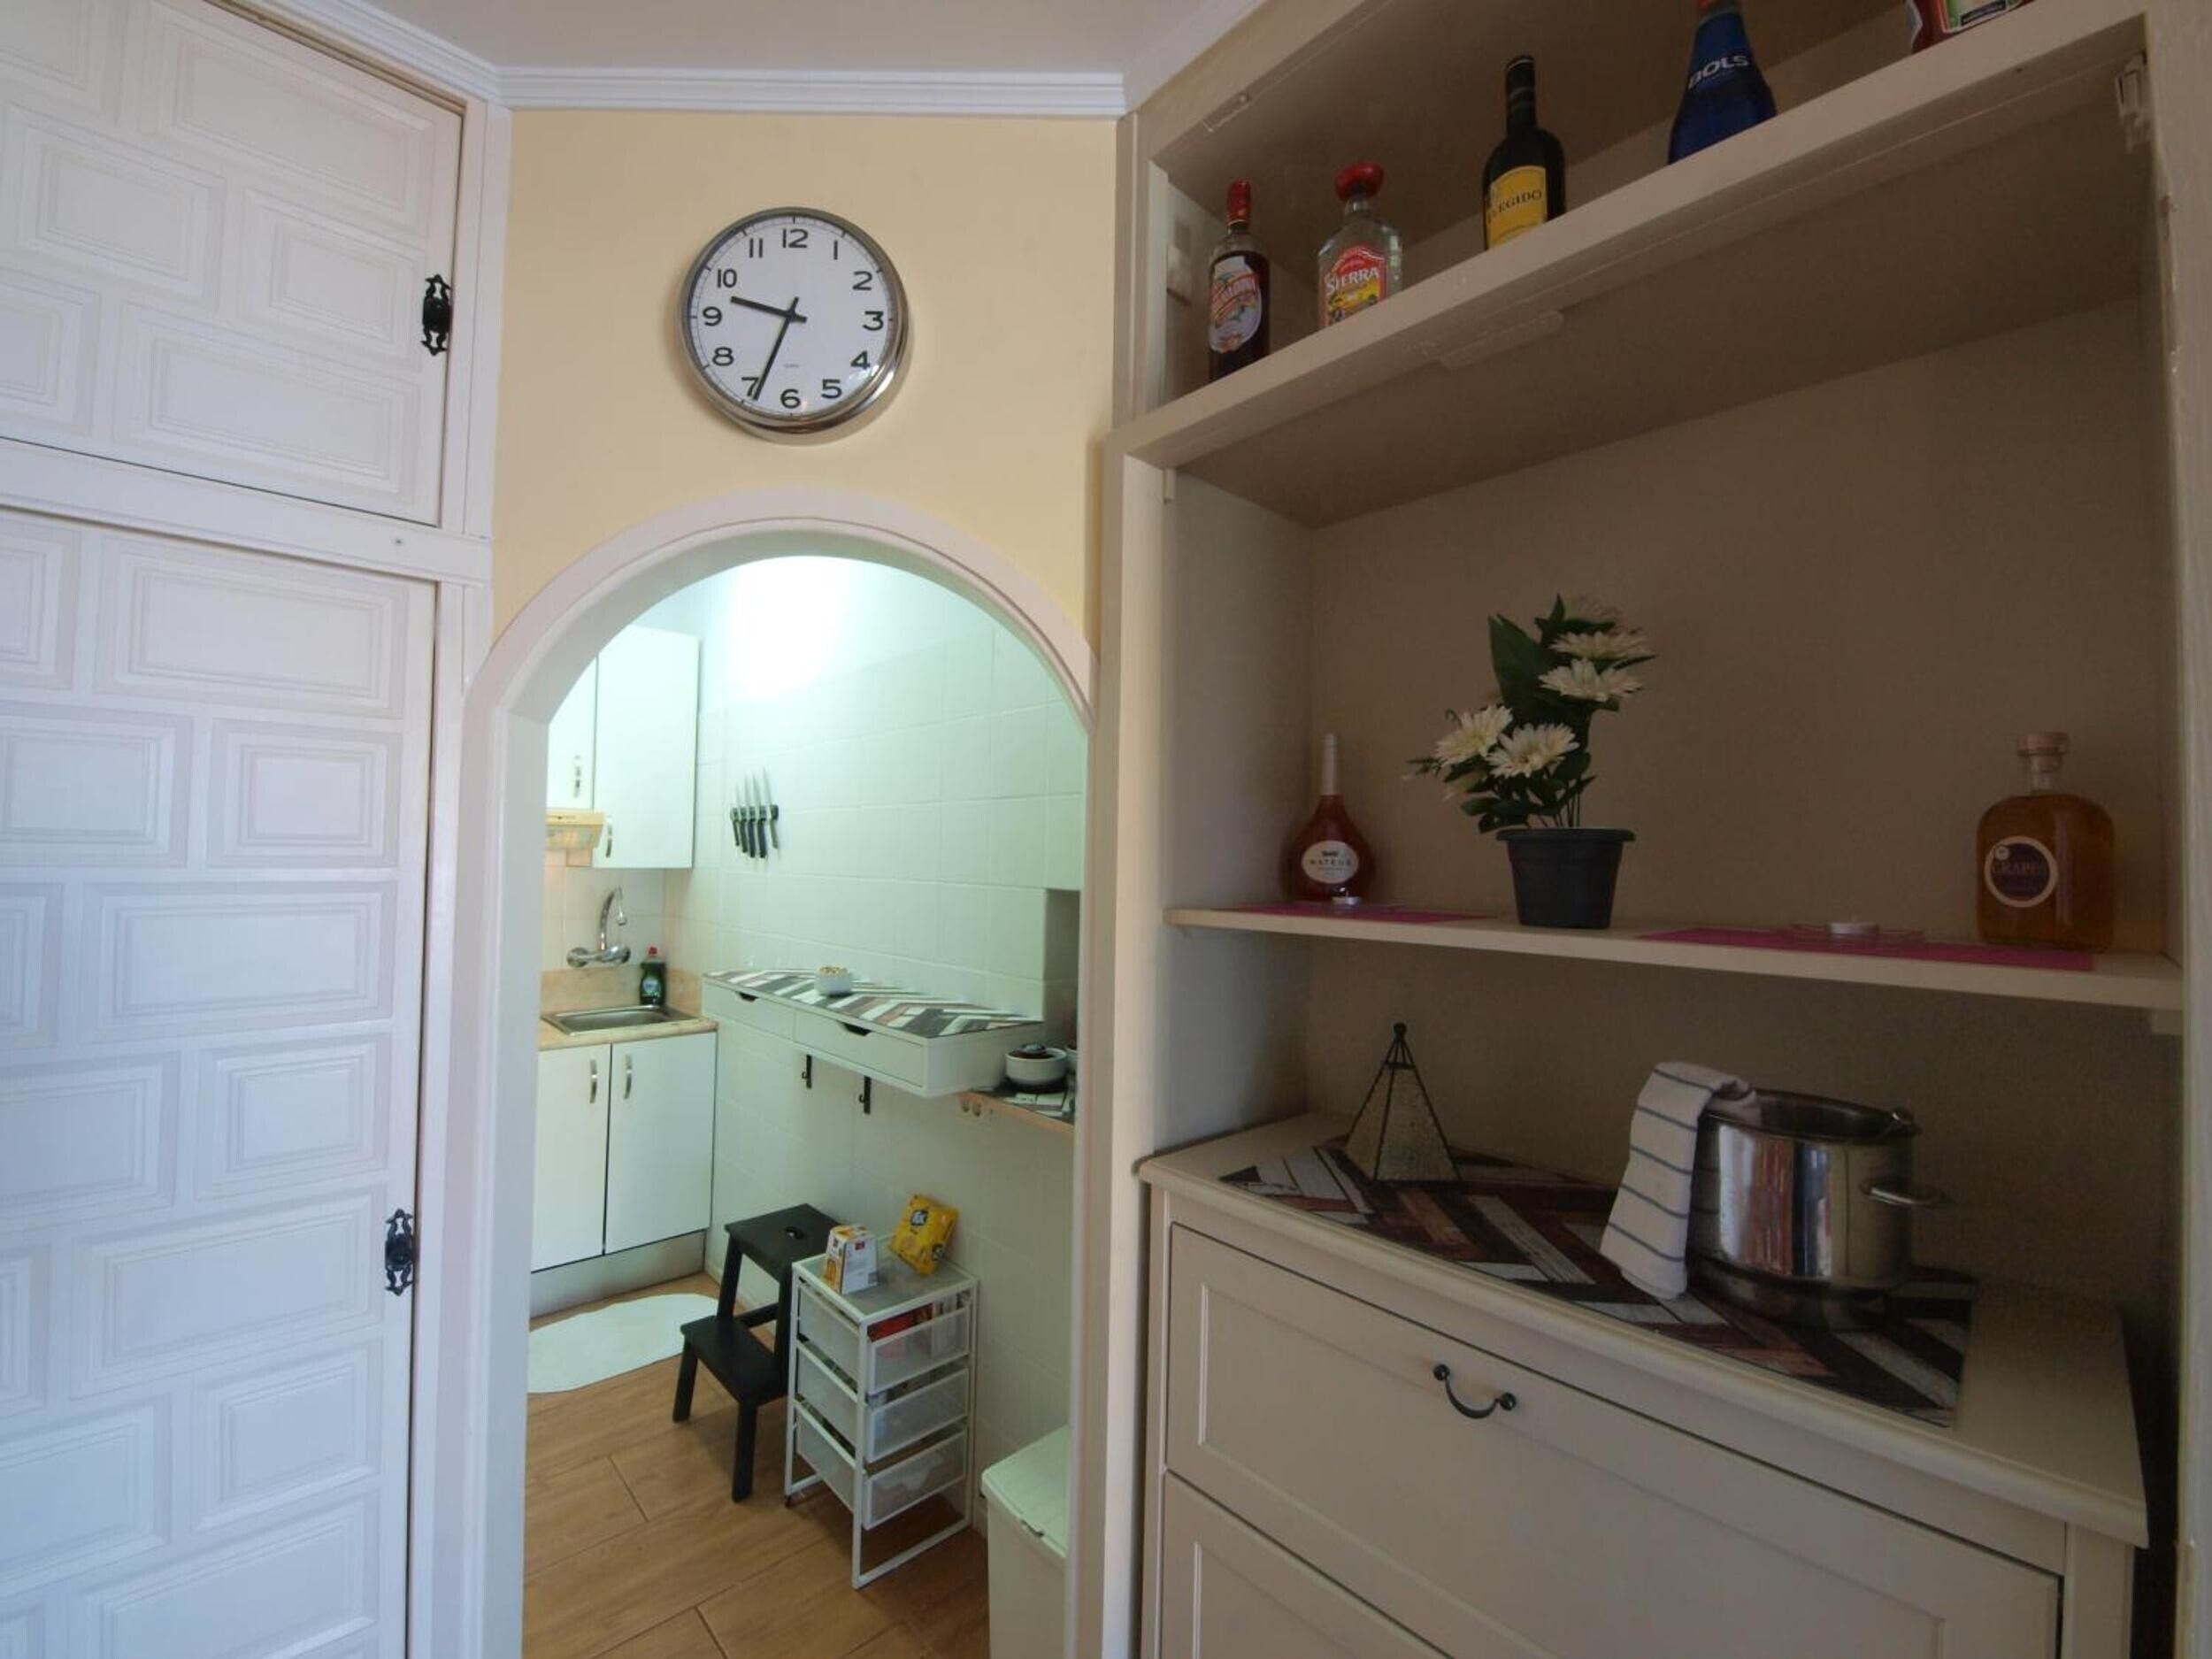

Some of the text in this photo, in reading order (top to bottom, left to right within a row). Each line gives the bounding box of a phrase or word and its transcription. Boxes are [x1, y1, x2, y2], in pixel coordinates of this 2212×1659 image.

[1687, 55, 1749, 90] BOLS
[749, 238, 764, 258] 11
[781, 228, 809, 249] 12
[833, 240, 839, 260] 1
[717, 268, 738, 288] 10
[851, 271, 873, 291] 2
[1325, 267, 1380, 296] SIERRA
[702, 306, 723, 326] 9
[863, 311, 884, 331] 3
[711, 347, 734, 367] 8
[850, 350, 871, 371] 4
[741, 376, 760, 397] 7
[821, 379, 842, 399] 5
[780, 389, 801, 410] 6
